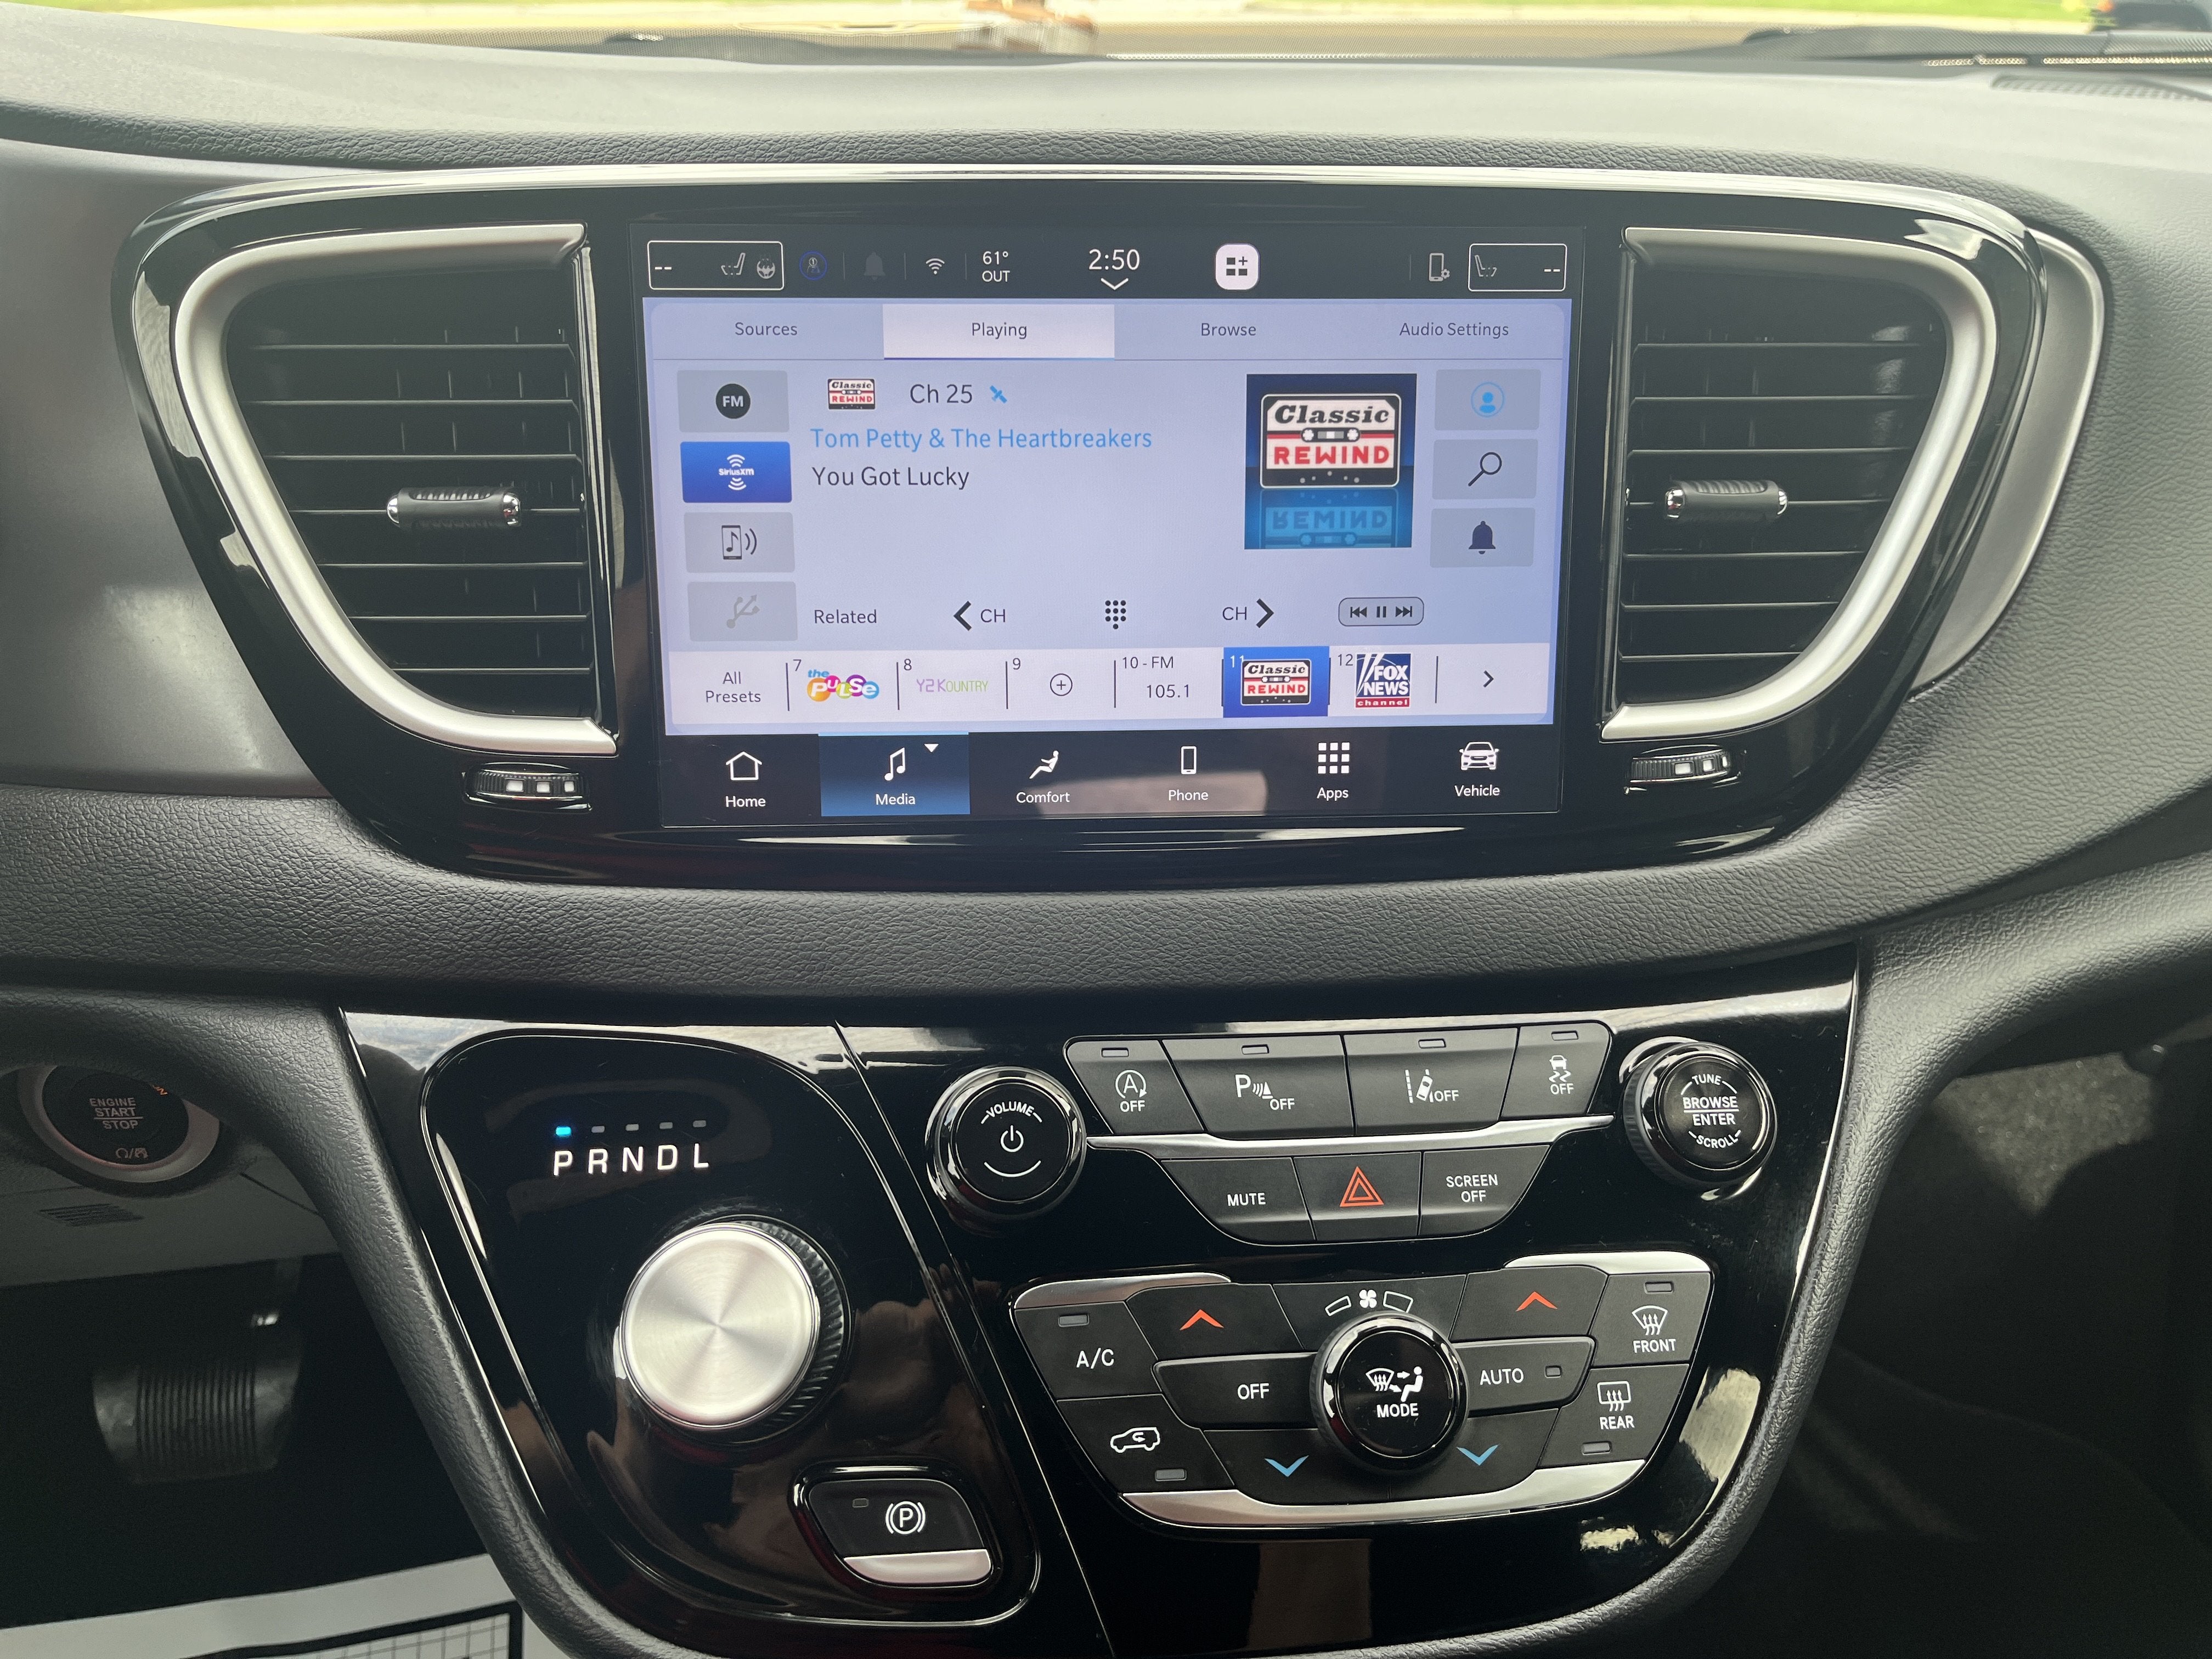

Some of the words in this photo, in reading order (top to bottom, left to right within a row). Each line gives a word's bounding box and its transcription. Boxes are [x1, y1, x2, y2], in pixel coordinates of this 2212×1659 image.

[1088, 249, 1140, 270] 2:50
[982, 270, 1011, 282] OUT
[735, 322, 797, 336] Sources
[972, 322, 1027, 340] Playing
[1201, 323, 1256, 336] Browse
[1399, 322, 1443, 336] Audio
[1447, 322, 1509, 339] Settings
[723, 395, 743, 407] FM
[910, 384, 939, 404] Ch
[946, 384, 973, 404] 25
[1274, 405, 1389, 424] Classic
[810, 428, 859, 448] Tom
[867, 428, 922, 453] Petty
[929, 428, 945, 448] &
[951, 428, 991, 448] The
[998, 428, 1152, 448] Heartbreakers
[1274, 445, 1390, 465] REWIND
[812, 467, 854, 486] You
[861, 466, 900, 486] Got
[908, 466, 969, 490] Lucky
[814, 609, 877, 624] Related
[980, 608, 1006, 623] CH
[1222, 606, 1247, 620] CH
[793, 659, 802, 672] 7
[904, 658, 912, 671] 8
[1013, 657, 1021, 670] 9
[1122, 656, 1138, 669] 10
[1152, 656, 1173, 669] FM
[1338, 653, 1353, 666] 12
[808, 669, 830, 678] the
[1248, 664, 1305, 674] Classic
[1373, 664, 1408, 680] FOX
[723, 671, 741, 685] All
[1147, 684, 1189, 698] 105.1
[1248, 684, 1306, 694] REWIND
[1363, 681, 1409, 696] NEWS
[706, 690, 761, 703] Presets
[1169, 789, 1209, 801] Phone
[1317, 787, 1349, 802] Apps
[1454, 784, 1500, 797] Vehicle
[725, 795, 766, 808] Home
[876, 793, 916, 805] Media
[1016, 792, 1070, 804] Comfort
[1691, 1074, 1722, 1086] TUNE
[1550, 1082, 1574, 1095] OFF
[89, 1097, 136, 1107] ENGINE
[1434, 1090, 1459, 1102] OFF
[1682, 1096, 1739, 1109] BROWSE
[986, 1101, 1035, 1118] VOLUME
[1120, 1099, 1146, 1113] OFF
[1269, 1098, 1295, 1110] OFF
[94, 1107, 136, 1117] START
[102, 1120, 138, 1130] STOP
[1692, 1113, 1736, 1126] ENTER
[1696, 1134, 1739, 1149] SCROLL
[553, 1150, 573, 1176] P
[588, 1148, 608, 1175] R
[622, 1146, 644, 1172] N
[657, 1144, 678, 1171] D
[693, 1143, 709, 1169] L
[1445, 1173, 1498, 1188] SCREEN
[1227, 1192, 1266, 1206] MUTE
[1460, 1189, 1486, 1203] OFF
[1632, 1338, 1676, 1353] FRONT
[1076, 1347, 1114, 1369] A/C
[1480, 1368, 1524, 1385] AUTO
[1237, 1383, 1269, 1400] OFF
[1376, 1403, 1419, 1418] MODE
[1599, 1415, 1635, 1430] REAR
